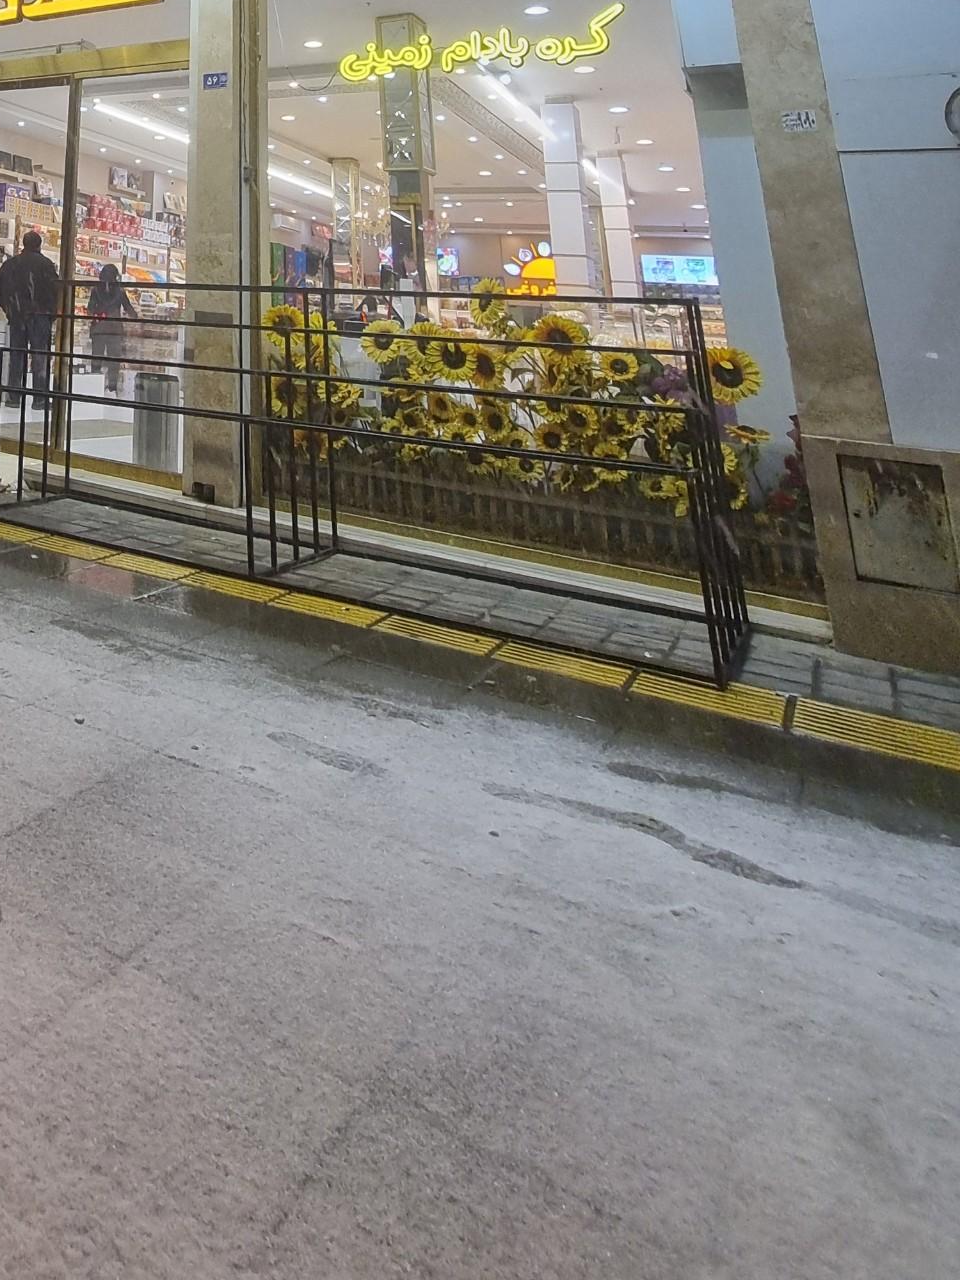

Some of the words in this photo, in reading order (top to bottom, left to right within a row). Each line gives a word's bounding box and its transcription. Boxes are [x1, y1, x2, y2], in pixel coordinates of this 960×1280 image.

[441, 26, 530, 72] بادام
[535, 2, 625, 65] کره
[340, 34, 432, 82] زمینی
